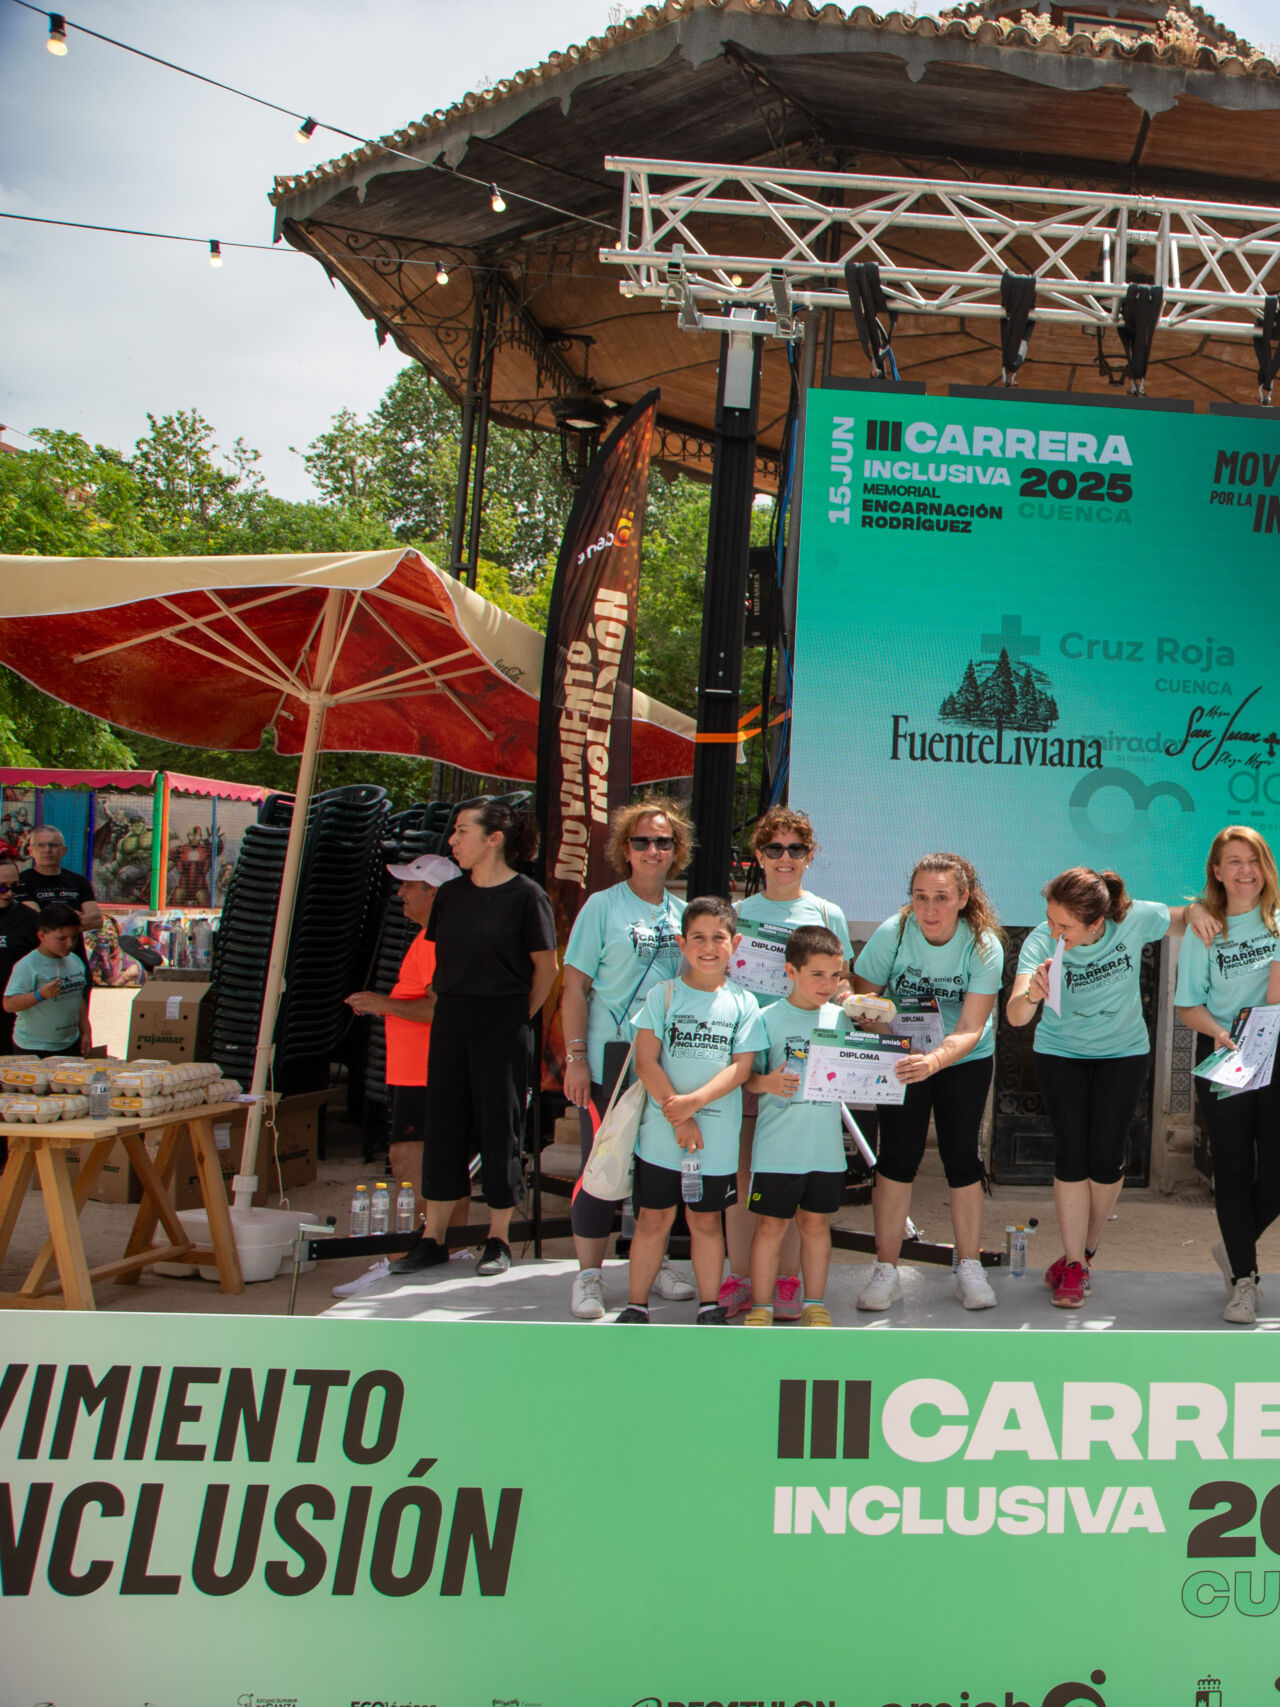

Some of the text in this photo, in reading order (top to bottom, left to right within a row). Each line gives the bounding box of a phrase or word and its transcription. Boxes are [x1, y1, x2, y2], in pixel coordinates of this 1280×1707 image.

[904, 421, 1133, 466] CARRERA
[863, 459, 1133, 503] INCLUSIVA 2025
[863, 483, 941, 499] MEMORIAL
[1210, 490, 1234, 506] POR
[1237, 491, 1253, 508] LA
[862, 499, 1003, 520] ENCARNACIÓN
[1018, 501, 1132, 525] CUENCA
[861, 516, 972, 534] RODRÍGUEZ
[1058, 631, 1235, 672] Cruz Roja
[1154, 677, 1233, 697] CUENCA
[1165, 686, 1263, 771] San Juan
[751, 941, 786, 954] DIPLOM
[1072, 957, 1124, 982] CARRERA
[137, 1033, 184, 1045] rujamar
[677, 1031, 730, 1045] CARRER
[679, 1041, 719, 1050] INCLUSIVA
[839, 1051, 880, 1061] DIPLOMA
[773, 1485, 1166, 1536] INCLUSIVA
